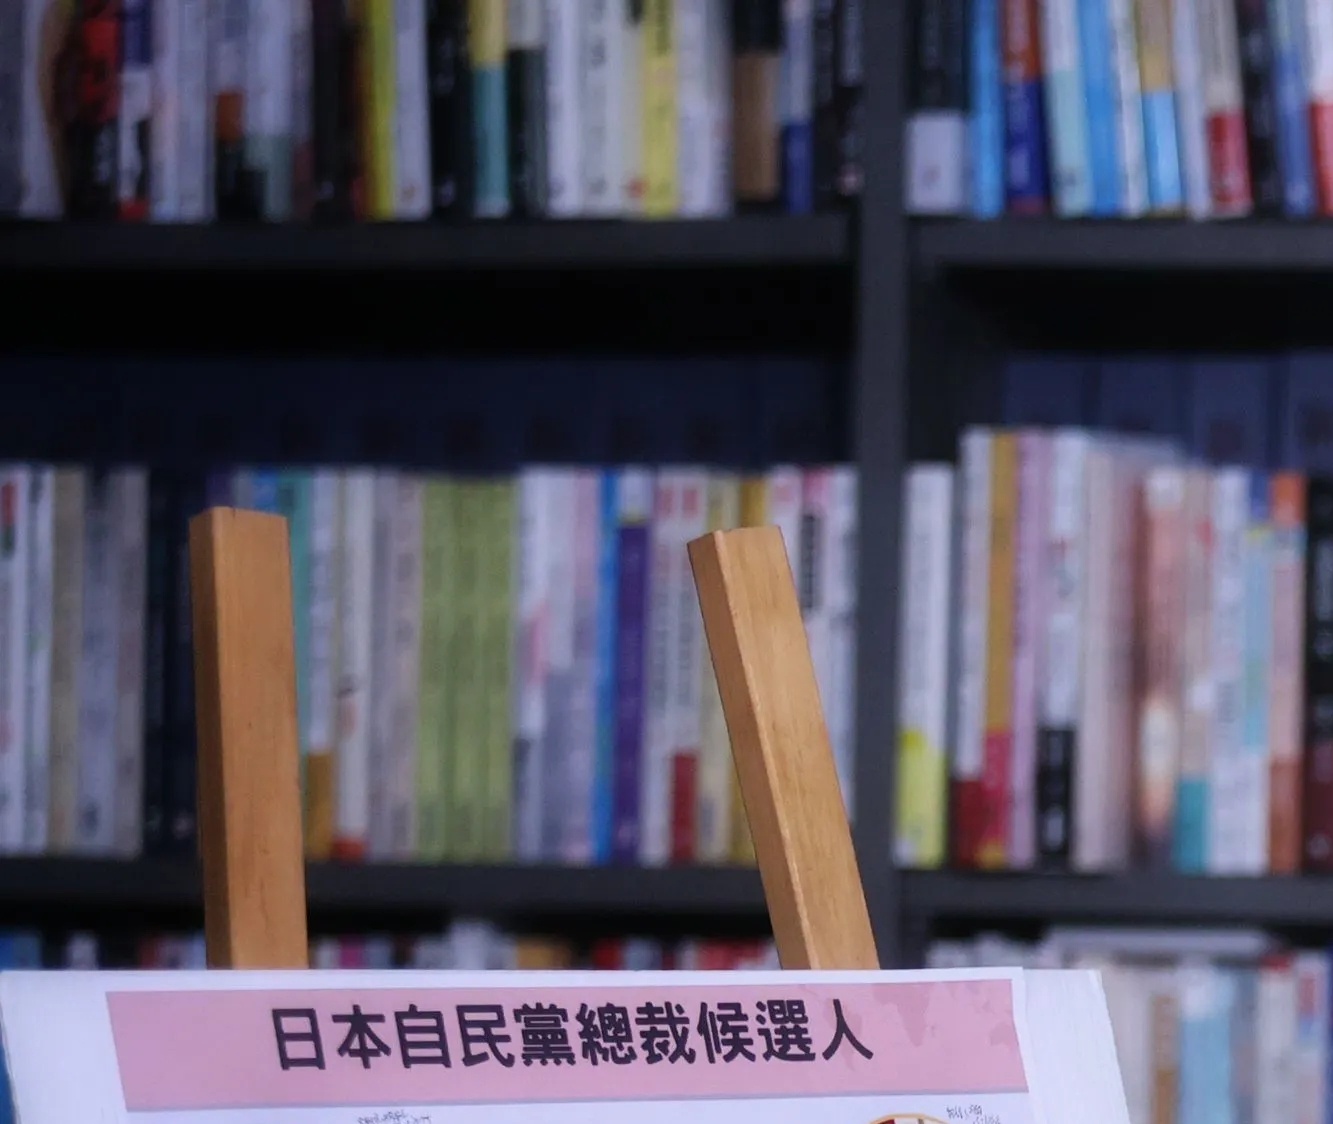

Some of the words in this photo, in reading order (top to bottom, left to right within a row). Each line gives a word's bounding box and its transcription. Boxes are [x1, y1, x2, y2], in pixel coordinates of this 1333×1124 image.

[271, 998, 874, 1071] 日本自民黨總裁候選人
